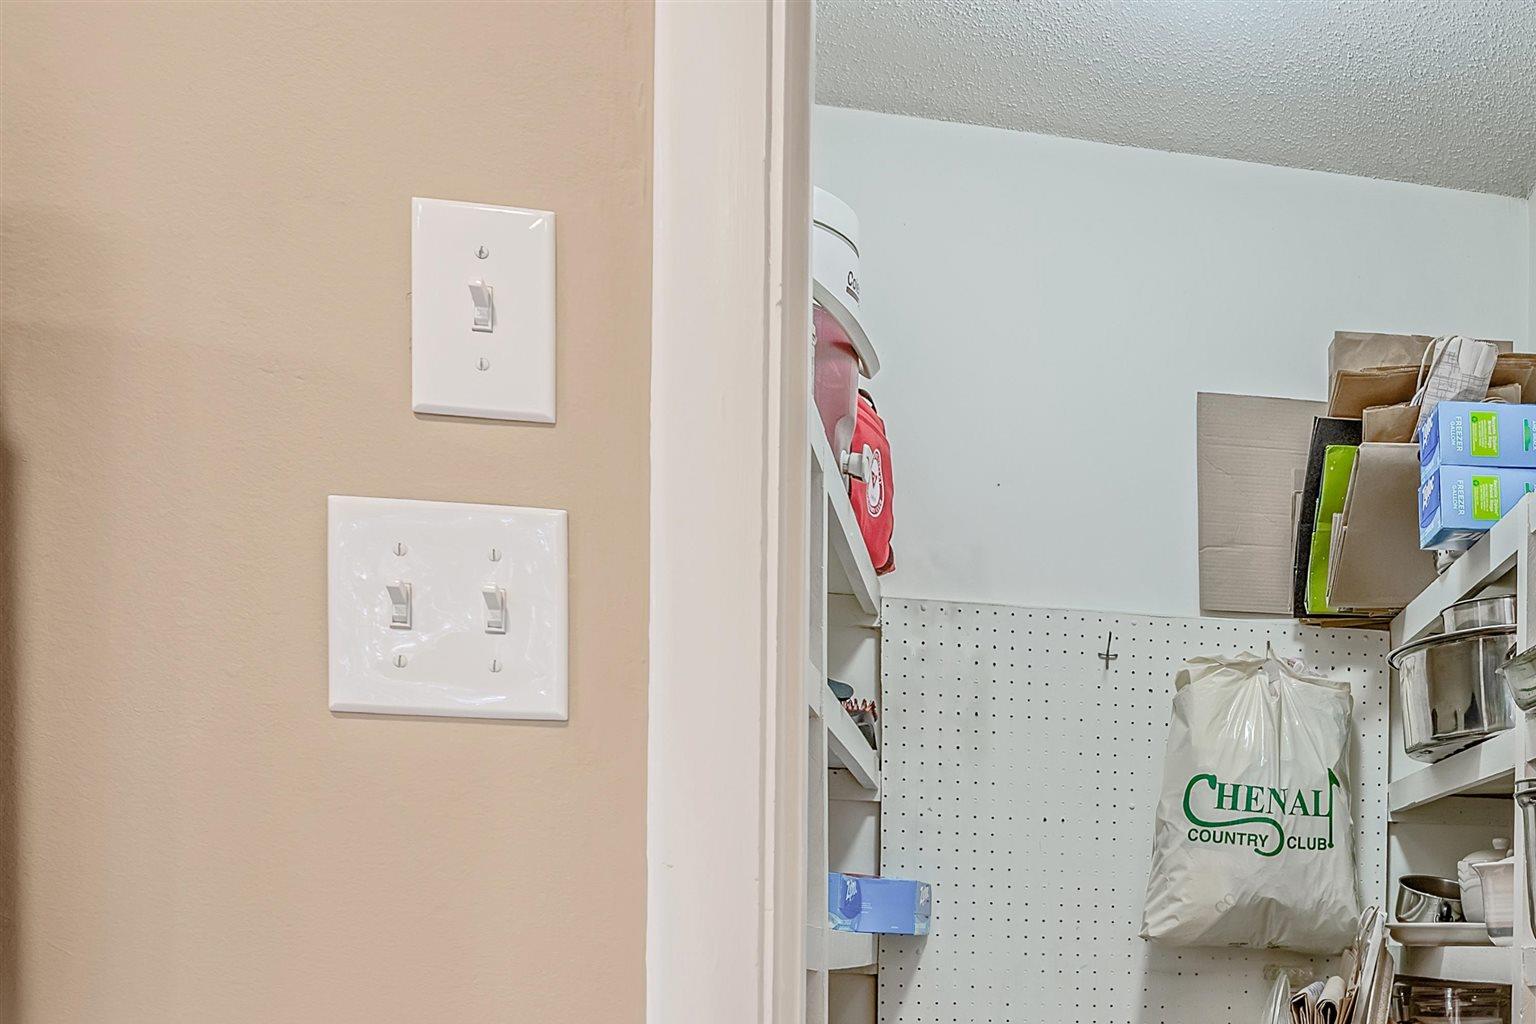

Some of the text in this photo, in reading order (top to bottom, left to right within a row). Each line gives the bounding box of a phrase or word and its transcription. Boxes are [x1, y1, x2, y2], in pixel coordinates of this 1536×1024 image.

[1456, 416, 1464, 452] FREEZER
[1457, 480, 1465, 516] FREEZER
[1183, 773, 1334, 846] CHENAL
[1187, 828, 1328, 850] COUNTRY CLUB
